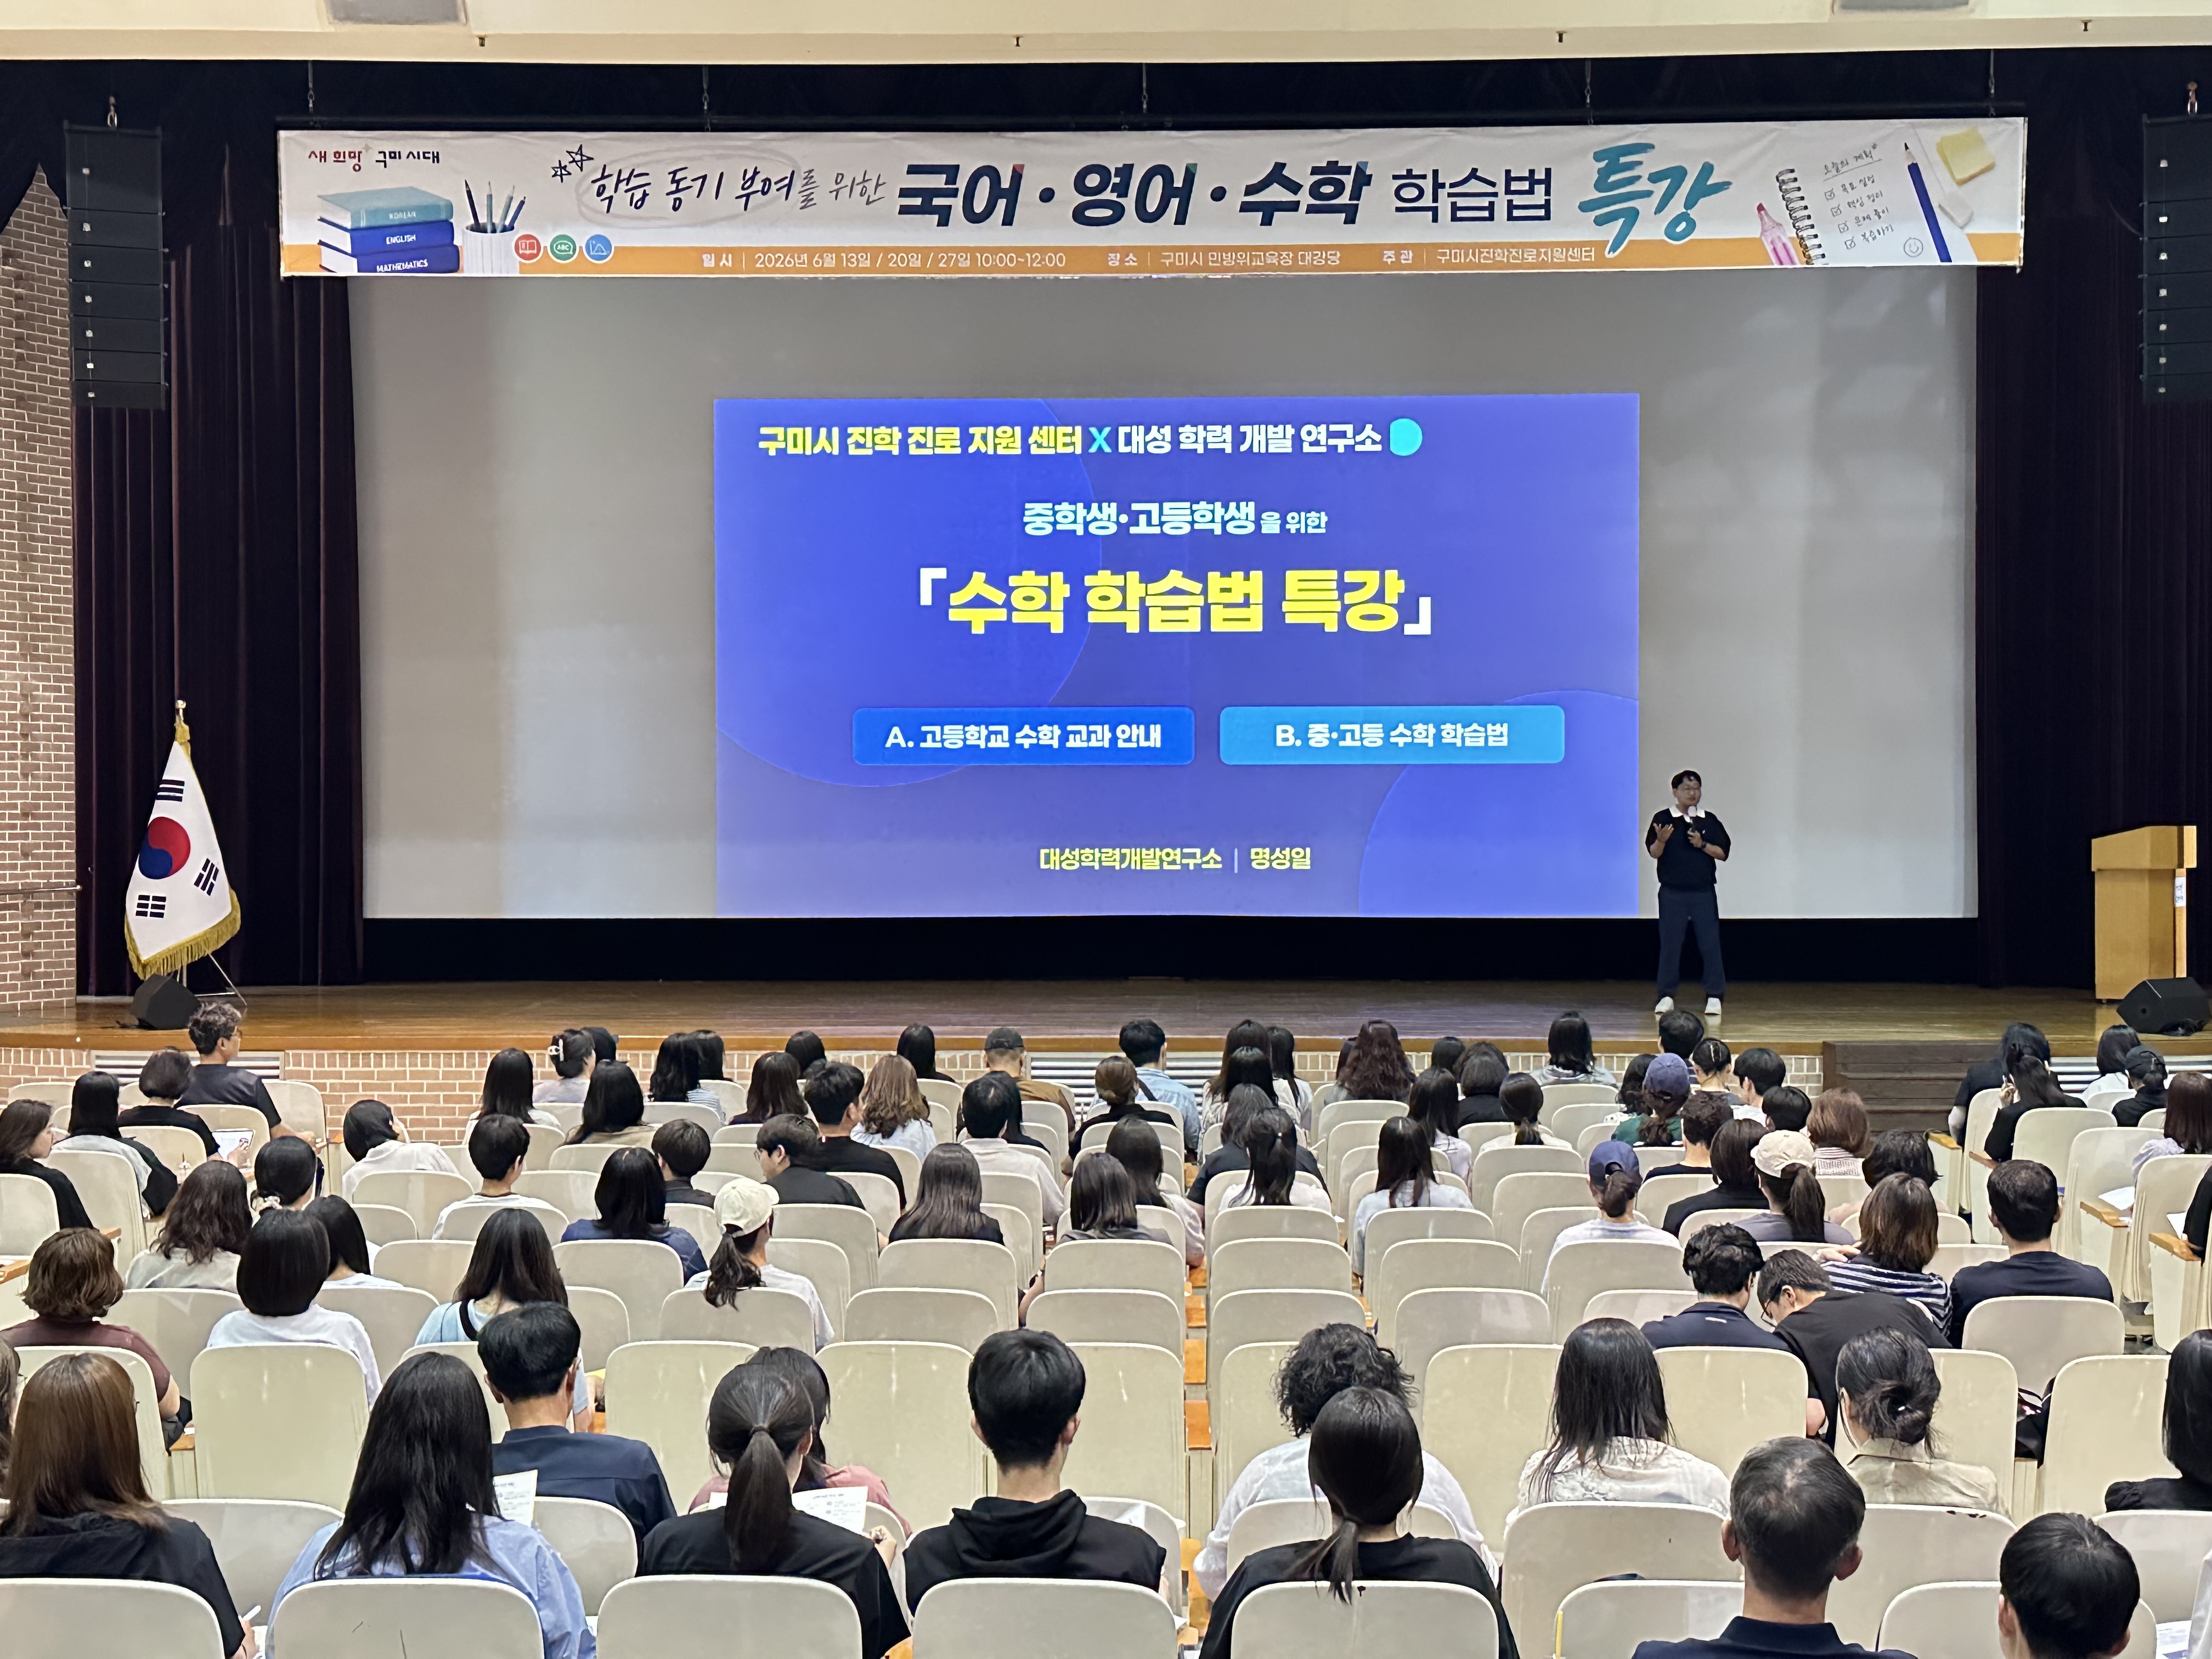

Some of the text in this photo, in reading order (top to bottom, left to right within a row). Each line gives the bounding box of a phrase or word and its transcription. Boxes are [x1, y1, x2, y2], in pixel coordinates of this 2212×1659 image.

[308, 150, 440, 172] 새 희망 구미 시대
[591, 164, 652, 213] 학습
[665, 166, 725, 212] 동기
[734, 166, 820, 211] 부여를
[828, 169, 887, 206] 위한
[898, 163, 1025, 227] 국어
[1071, 162, 1198, 227] 영어
[1239, 160, 1373, 227] 수학
[1392, 167, 1553, 223] 학습법
[1578, 142, 1733, 257] 특강
[386, 234, 416, 245] ENGLISH
[376, 259, 428, 272] MATHEMATICS
[754, 253, 808, 268] 2026년
[812, 253, 836, 268] 6월
[840, 253, 871, 268] 13일
[888, 253, 922, 268] 20일
[938, 252, 971, 268] 27일
[975, 252, 1066, 268] 10:00~12:00
[1161, 252, 1203, 267] 구미시
[1436, 247, 1595, 264] 구미시진학진로지원센터
[758, 427, 839, 456] 구미시
[847, 427, 901, 455] 진학
[907, 427, 962, 455] 진로
[968, 426, 1022, 455] 지원
[1028, 426, 1082, 455] 센터
[1118, 425, 1172, 454] 대성
[1178, 425, 1233, 454] 학력
[1239, 425, 1295, 453] 개발
[1300, 424, 1383, 453] 연구소
[1285, 511, 1328, 534] 위한
[1084, 569, 1263, 634] 학습법
[885, 724, 1161, 749] A. 고등학교 수학 교과 안내
[1276, 722, 1509, 748] B. 중·고등 수학 학습법
[1039, 847, 1312, 871] 대성학력개발연구소 명성일
